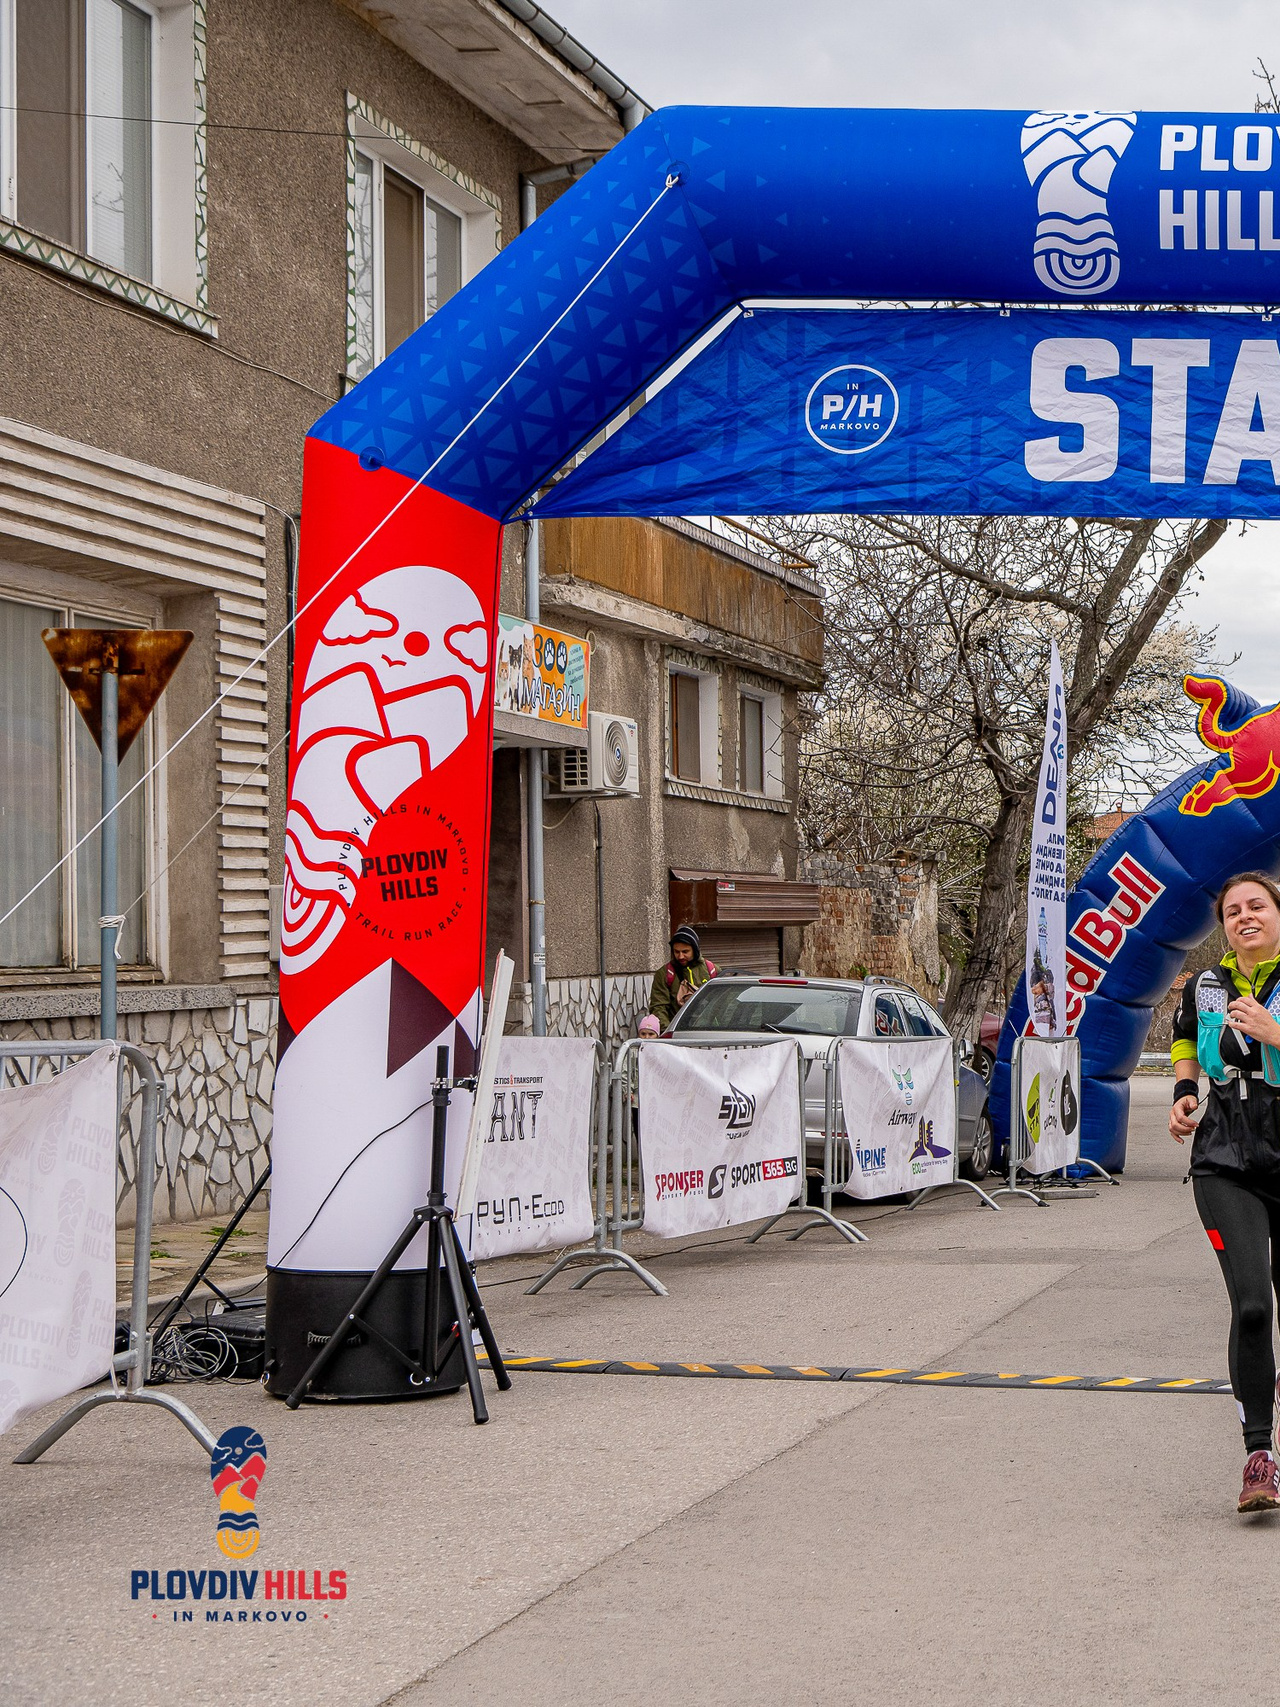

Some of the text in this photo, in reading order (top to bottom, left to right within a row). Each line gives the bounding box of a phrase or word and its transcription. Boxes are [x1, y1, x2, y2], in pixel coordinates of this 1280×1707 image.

[822, 394, 883, 421] P/H
[522, 676, 581, 722] МАГАЗИН
[337, 804, 469, 891] PLOVDIV HILLS IN MARKOVO
[361, 848, 448, 878] PLOVDIV
[380, 876, 439, 902] HILLS
[355, 902, 463, 941] TRAIL RUN RACE
[1073, 856, 1162, 959] Bull
[493, 1076, 543, 1085] STICS TRANSPORT
[485, 1091, 544, 1143] ANT
[888, 1109, 917, 1128] Airway
[655, 1169, 704, 1202] SPONSER
